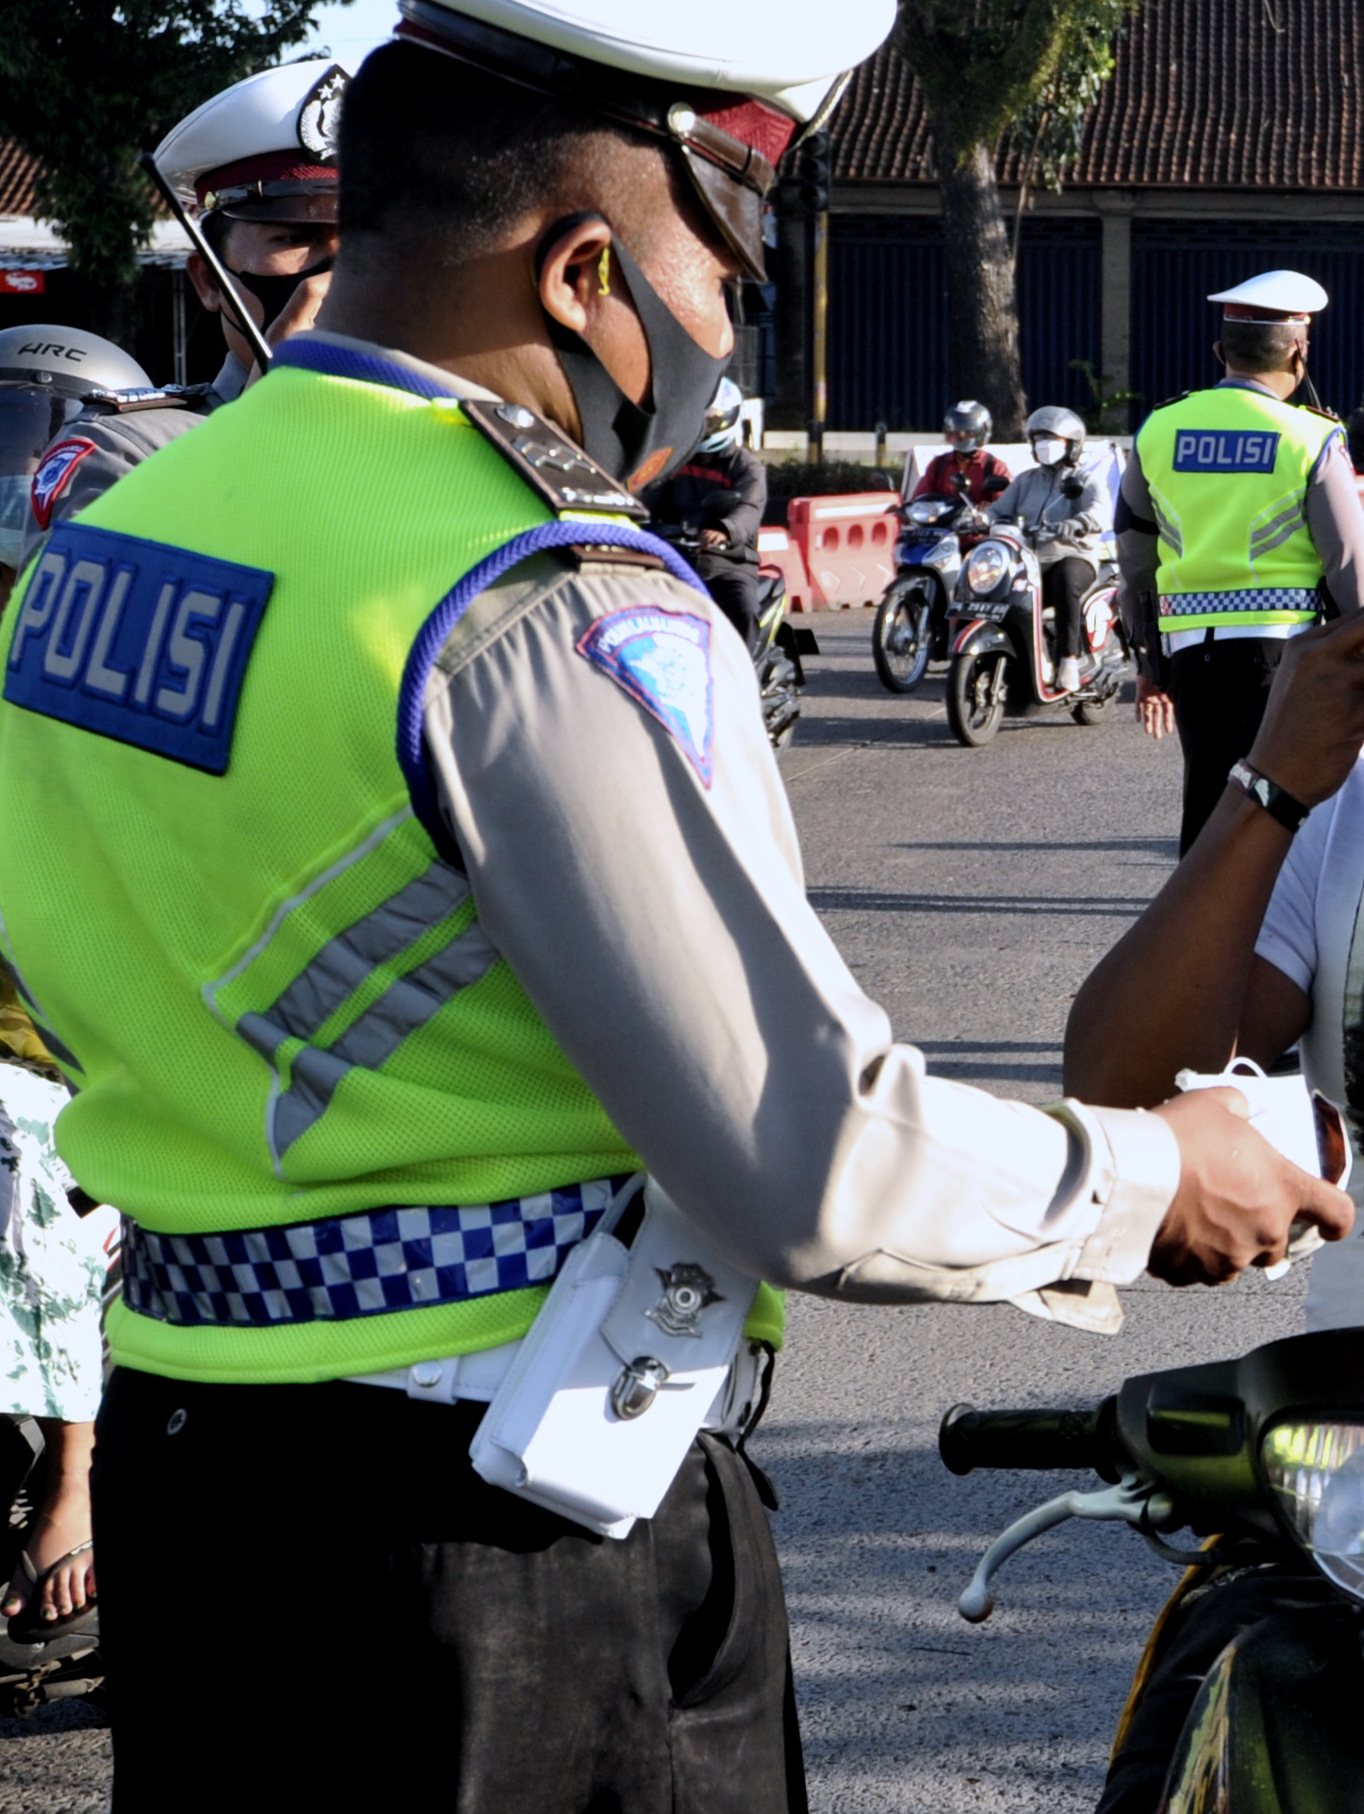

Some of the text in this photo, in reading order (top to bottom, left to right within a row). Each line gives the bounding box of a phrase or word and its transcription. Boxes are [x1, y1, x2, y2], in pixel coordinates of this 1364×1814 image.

[17, 342, 87, 362] HRC
[1176, 436, 1273, 465] POLISI
[10, 552, 246, 727] POLISI
